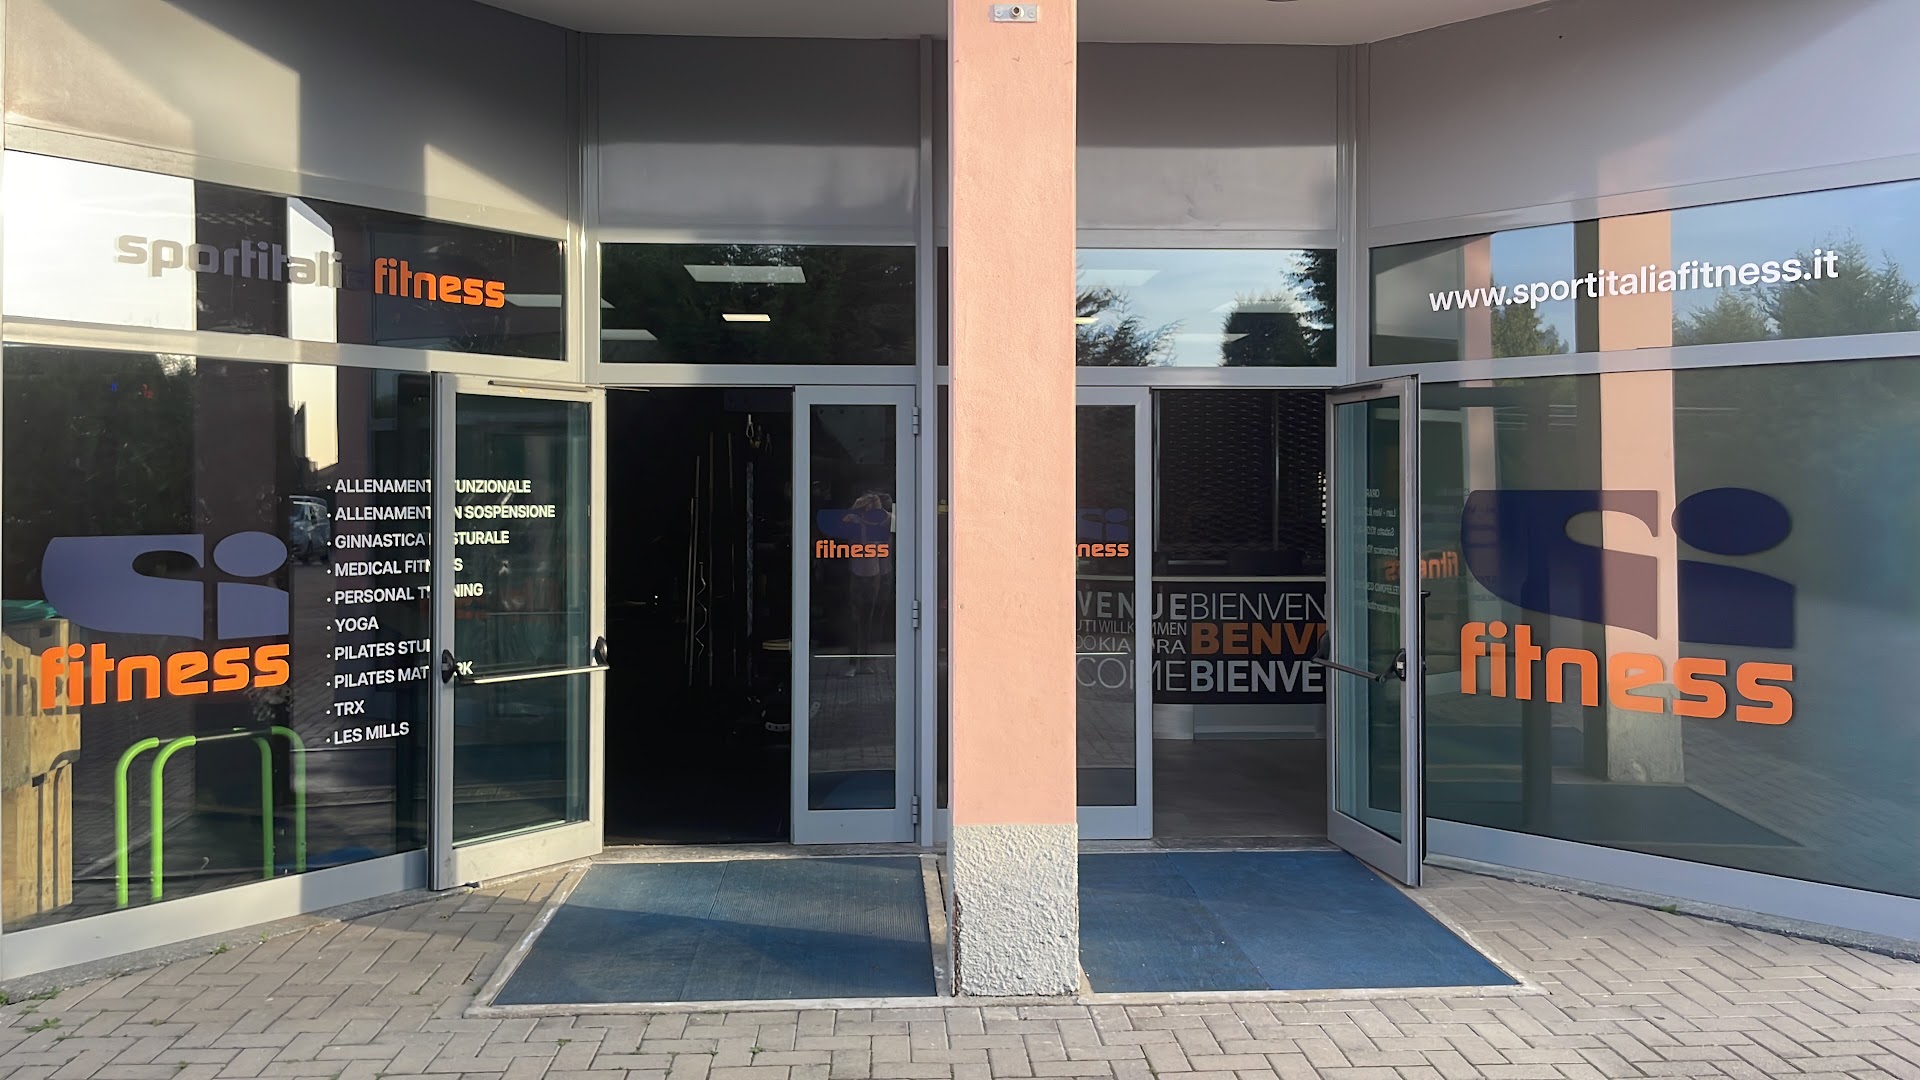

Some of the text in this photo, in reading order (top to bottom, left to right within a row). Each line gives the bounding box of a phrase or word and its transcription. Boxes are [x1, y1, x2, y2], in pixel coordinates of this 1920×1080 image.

[117, 234, 506, 309] sportitali fitness
[1429, 249, 1839, 312] www.sportitaliafitness.it
[335, 479, 531, 493] ALLENAMENT UNZIONALE
[335, 504, 556, 521] ALLENAMENT N SOSPENSIONE
[335, 530, 510, 549] GINNASTICA STURALE
[816, 539, 889, 558] fitness
[1076, 543, 1129, 557] ness
[335, 557, 464, 577] MEDICAL FITNS
[335, 582, 484, 605] PERSONAL TNING
[1076, 591, 1326, 620] VENUE BIENVEN
[335, 616, 379, 633] YOGA
[1098, 619, 1187, 636] WILLKMEN
[334, 638, 430, 661] PILATES STU
[1099, 636, 1132, 653] KIA
[40, 643, 290, 710] fitness
[334, 660, 474, 689] PILATES MATRK
[1076, 656, 1324, 692] COME BIENVE
[1460, 621, 1794, 726] fitness
[334, 700, 365, 717] TRX
[334, 721, 410, 745] LES MILLS
